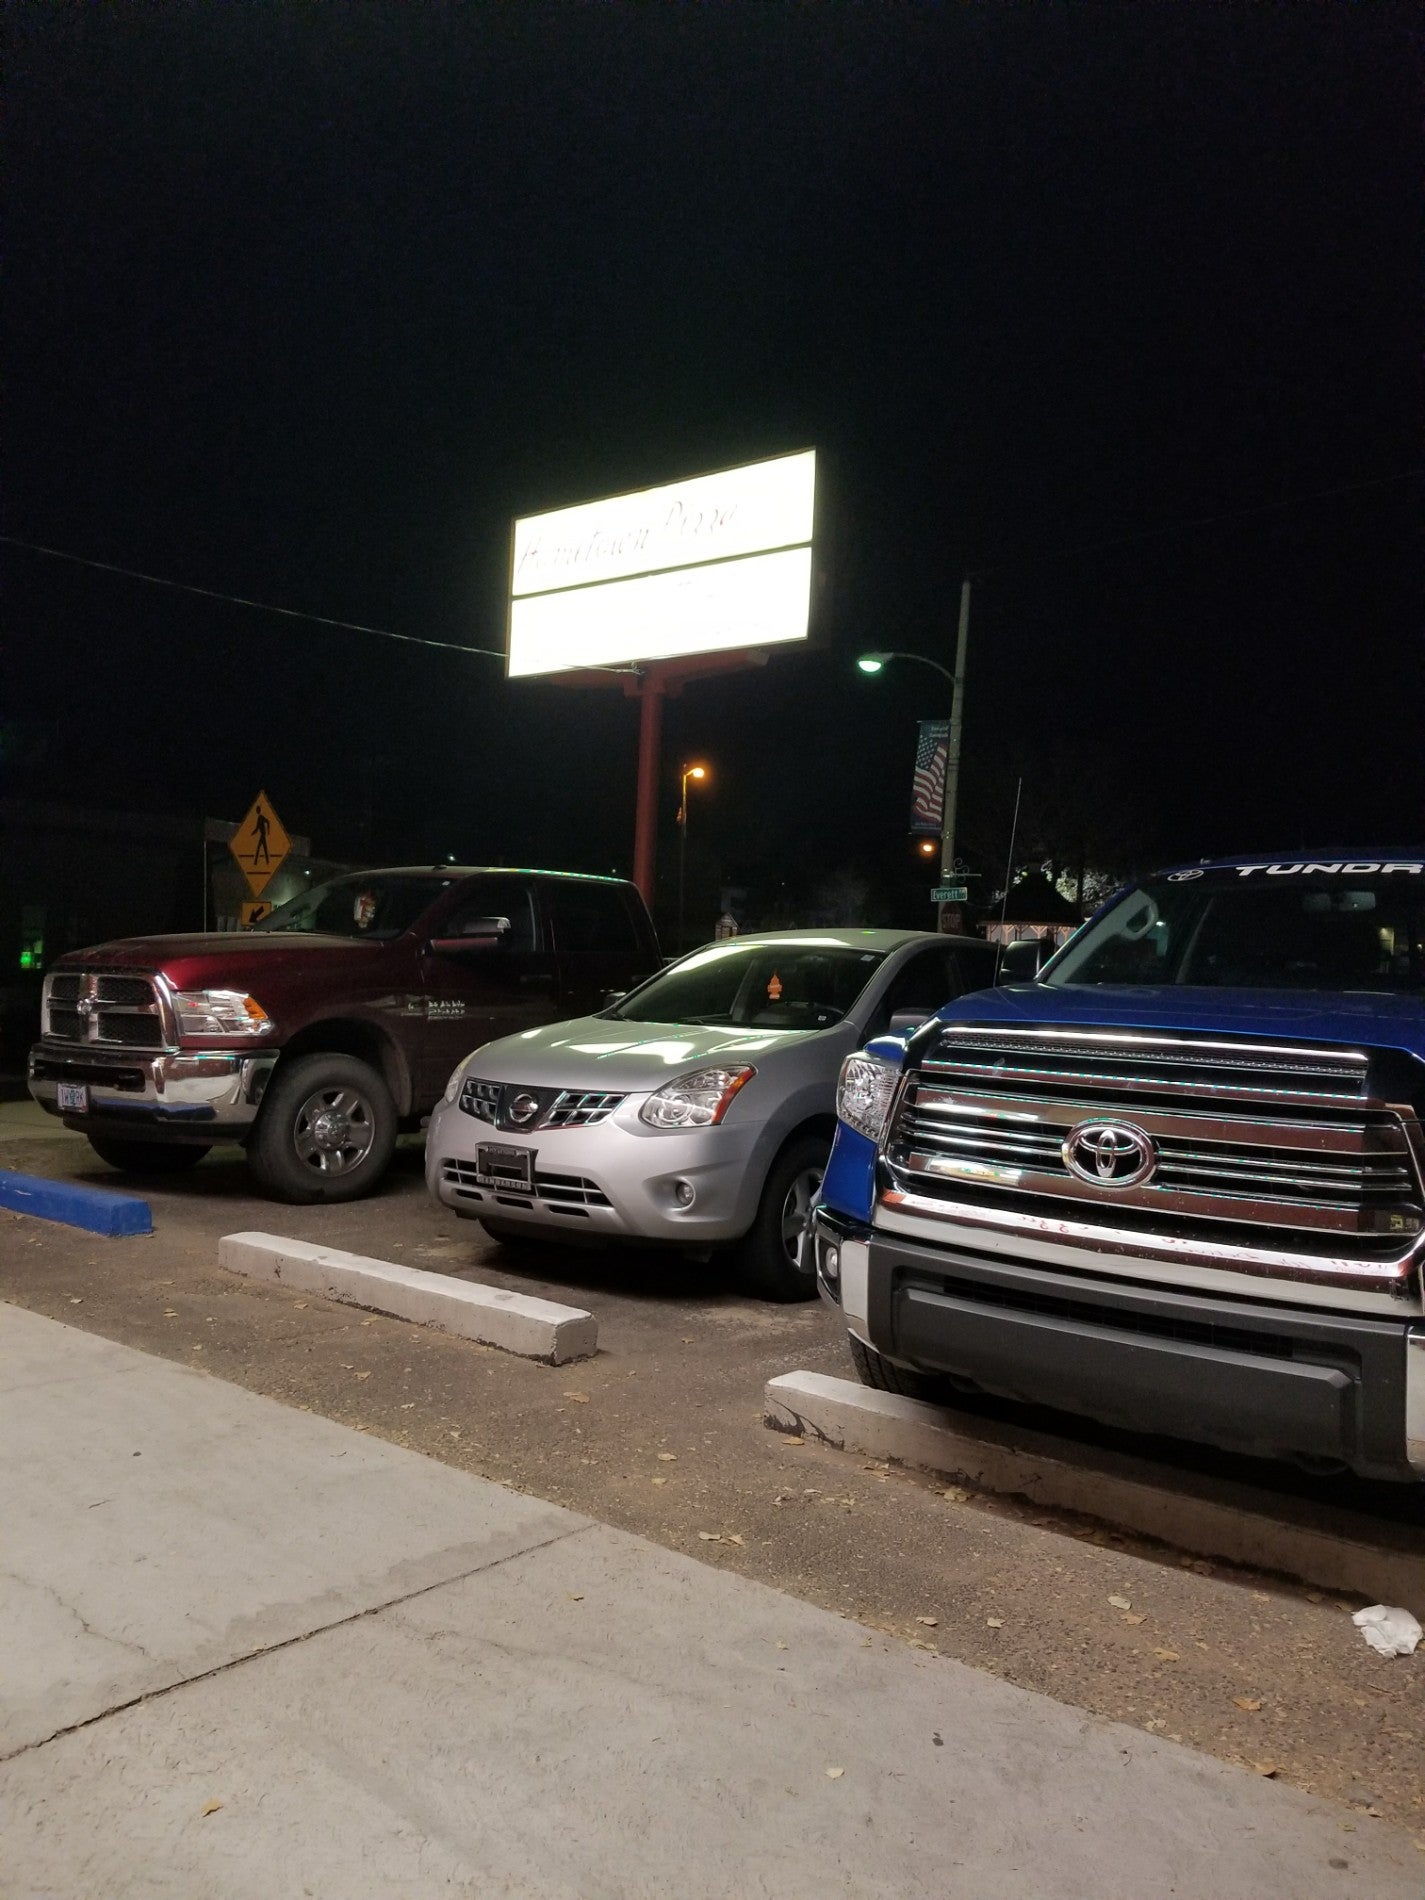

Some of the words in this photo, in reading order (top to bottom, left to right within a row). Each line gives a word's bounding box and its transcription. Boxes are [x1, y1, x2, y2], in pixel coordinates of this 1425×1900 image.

[517, 528, 649, 574] Hmtown
[663, 500, 738, 536] Pizza
[933, 890, 958, 900] Everett
